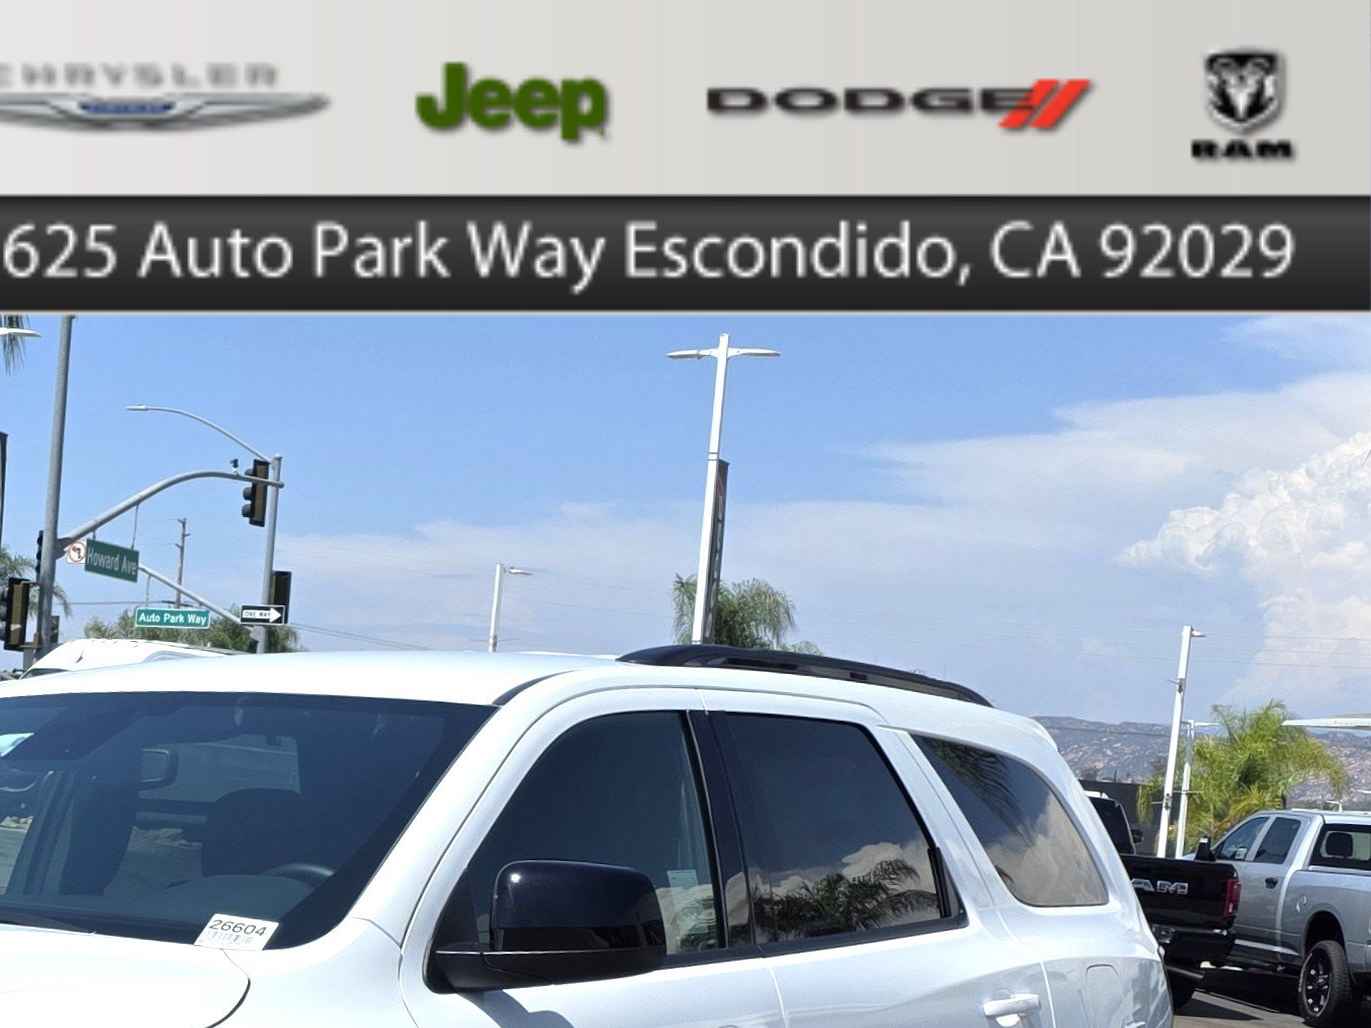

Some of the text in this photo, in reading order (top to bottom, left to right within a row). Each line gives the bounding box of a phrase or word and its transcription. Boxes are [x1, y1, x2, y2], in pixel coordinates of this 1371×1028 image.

[86, 547, 137, 576] Howard Ave
[138, 613, 207, 626] Auto Park Way
[1130, 877, 1189, 895] AM
[209, 919, 267, 936] 26604
